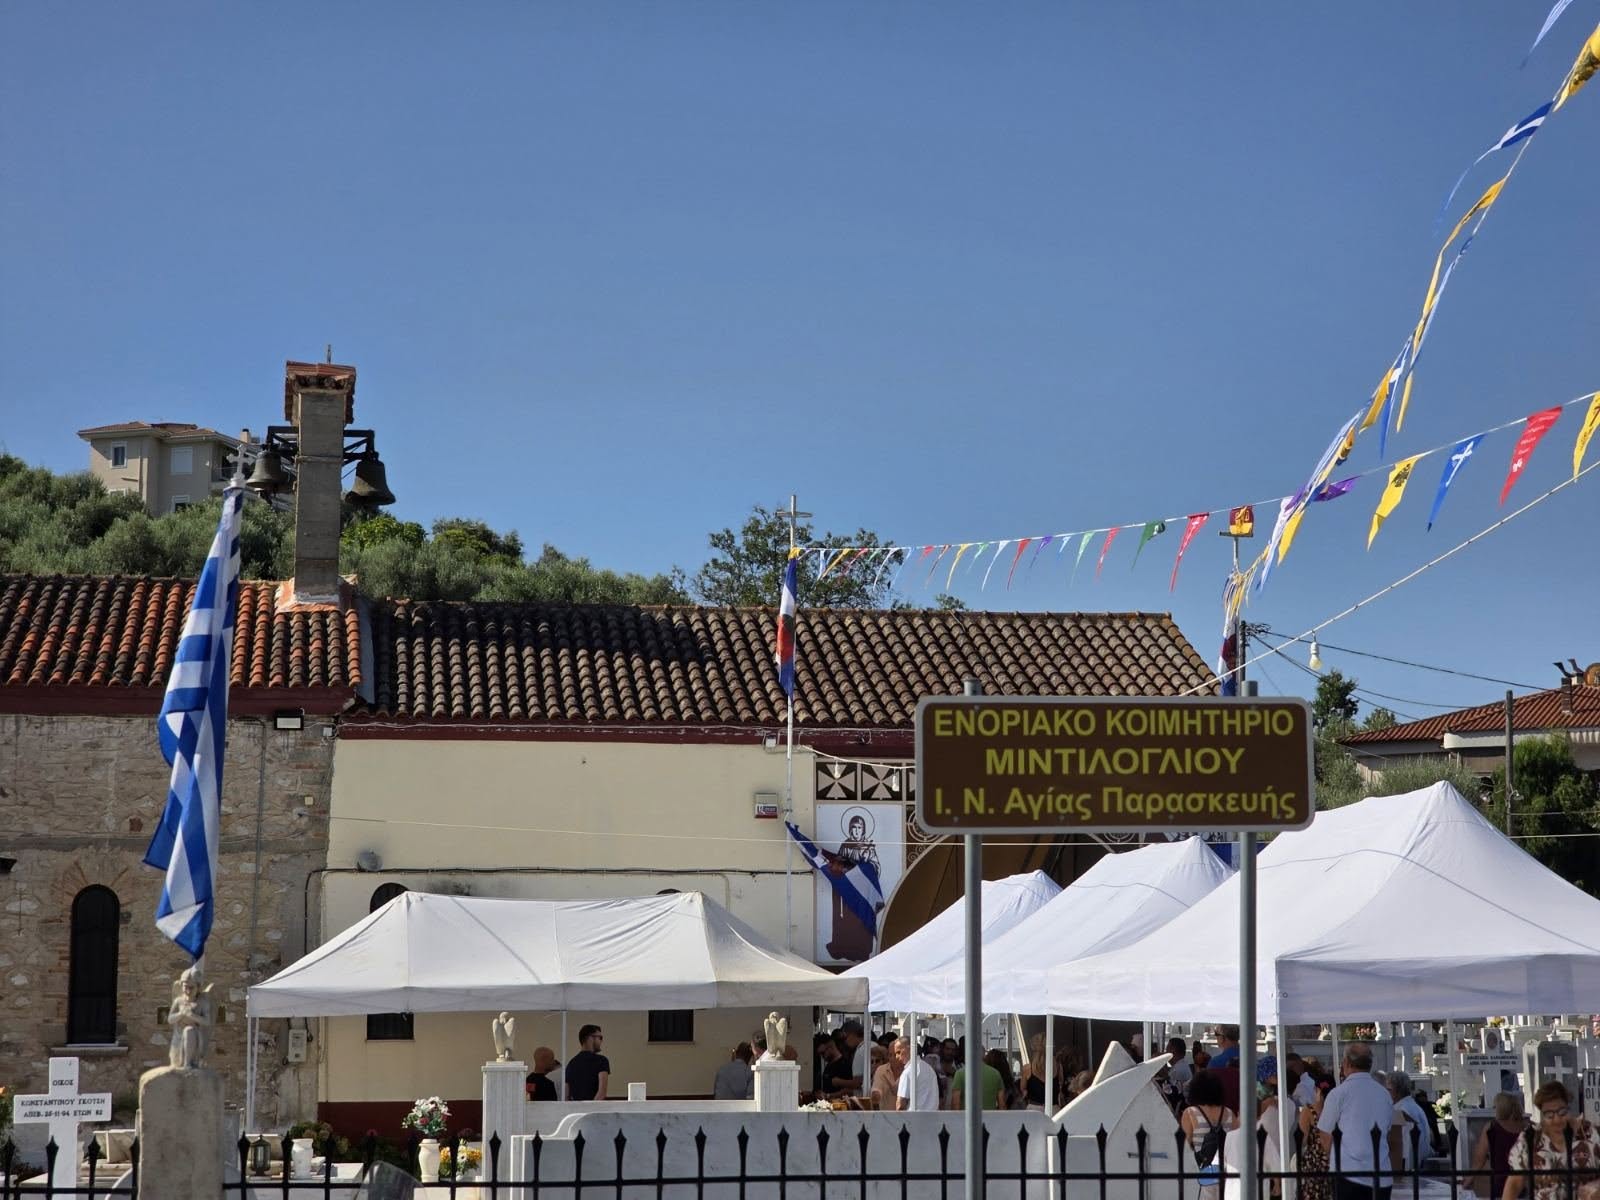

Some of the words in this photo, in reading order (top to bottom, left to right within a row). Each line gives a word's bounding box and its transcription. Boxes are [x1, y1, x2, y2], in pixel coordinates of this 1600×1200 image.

[934, 709, 1096, 737] ΕΝΟΡΙΑΚΟ
[1105, 709, 1294, 737] ΚΟΙΜΗΤΗΡΙΟ
[985, 747, 1246, 775] ΜΙΝΤΙΛΟΓΛΙΟΥ
[935, 788, 952, 816] Ι.
[963, 787, 995, 815] Ν.
[1004, 786, 1093, 821] Αγίας
[1102, 786, 1296, 820] Παρασκευής
